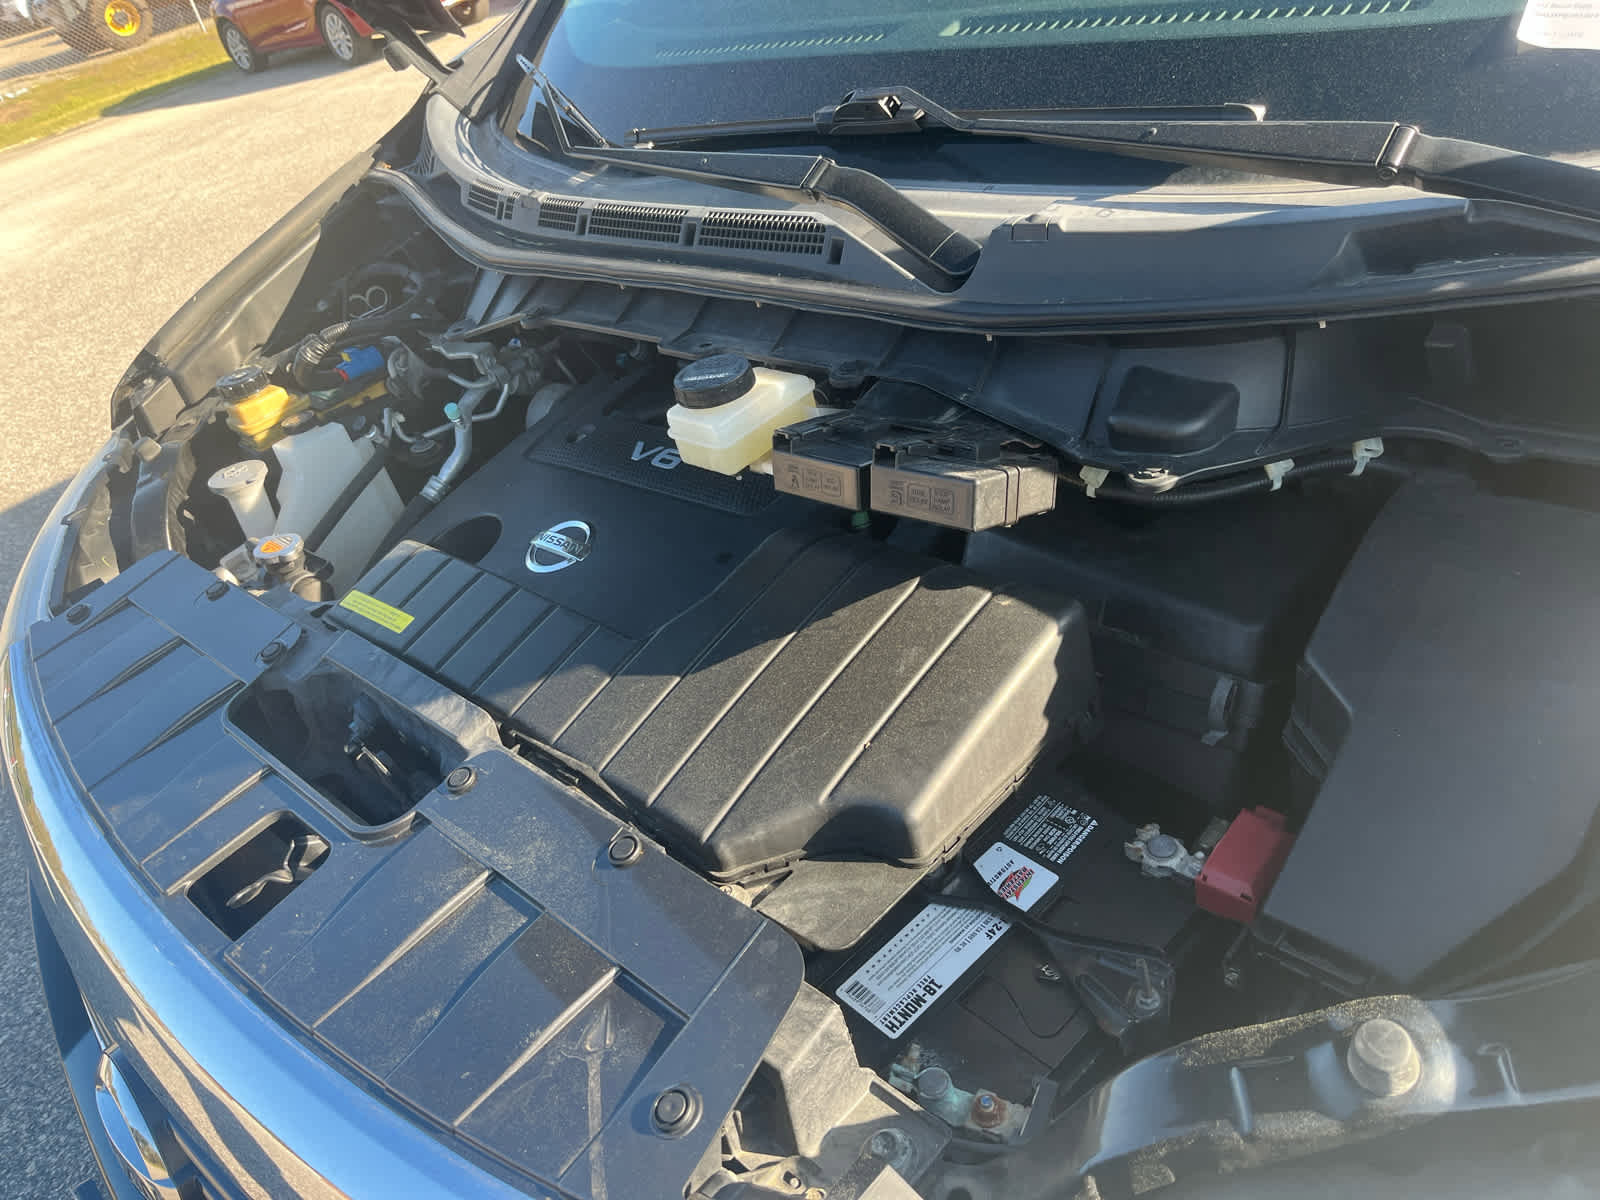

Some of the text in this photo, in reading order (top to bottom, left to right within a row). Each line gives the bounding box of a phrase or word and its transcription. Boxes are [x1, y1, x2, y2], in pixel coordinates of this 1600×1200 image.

[630, 441, 682, 470] V6
[538, 531, 585, 557] NISSAN
[999, 865, 1028, 897] BATTERIE
[1003, 868, 1035, 899] INTERSTAT
[880, 988, 917, 1025] REPLACEMENT
[885, 978, 943, 1034] 18-MONTH
